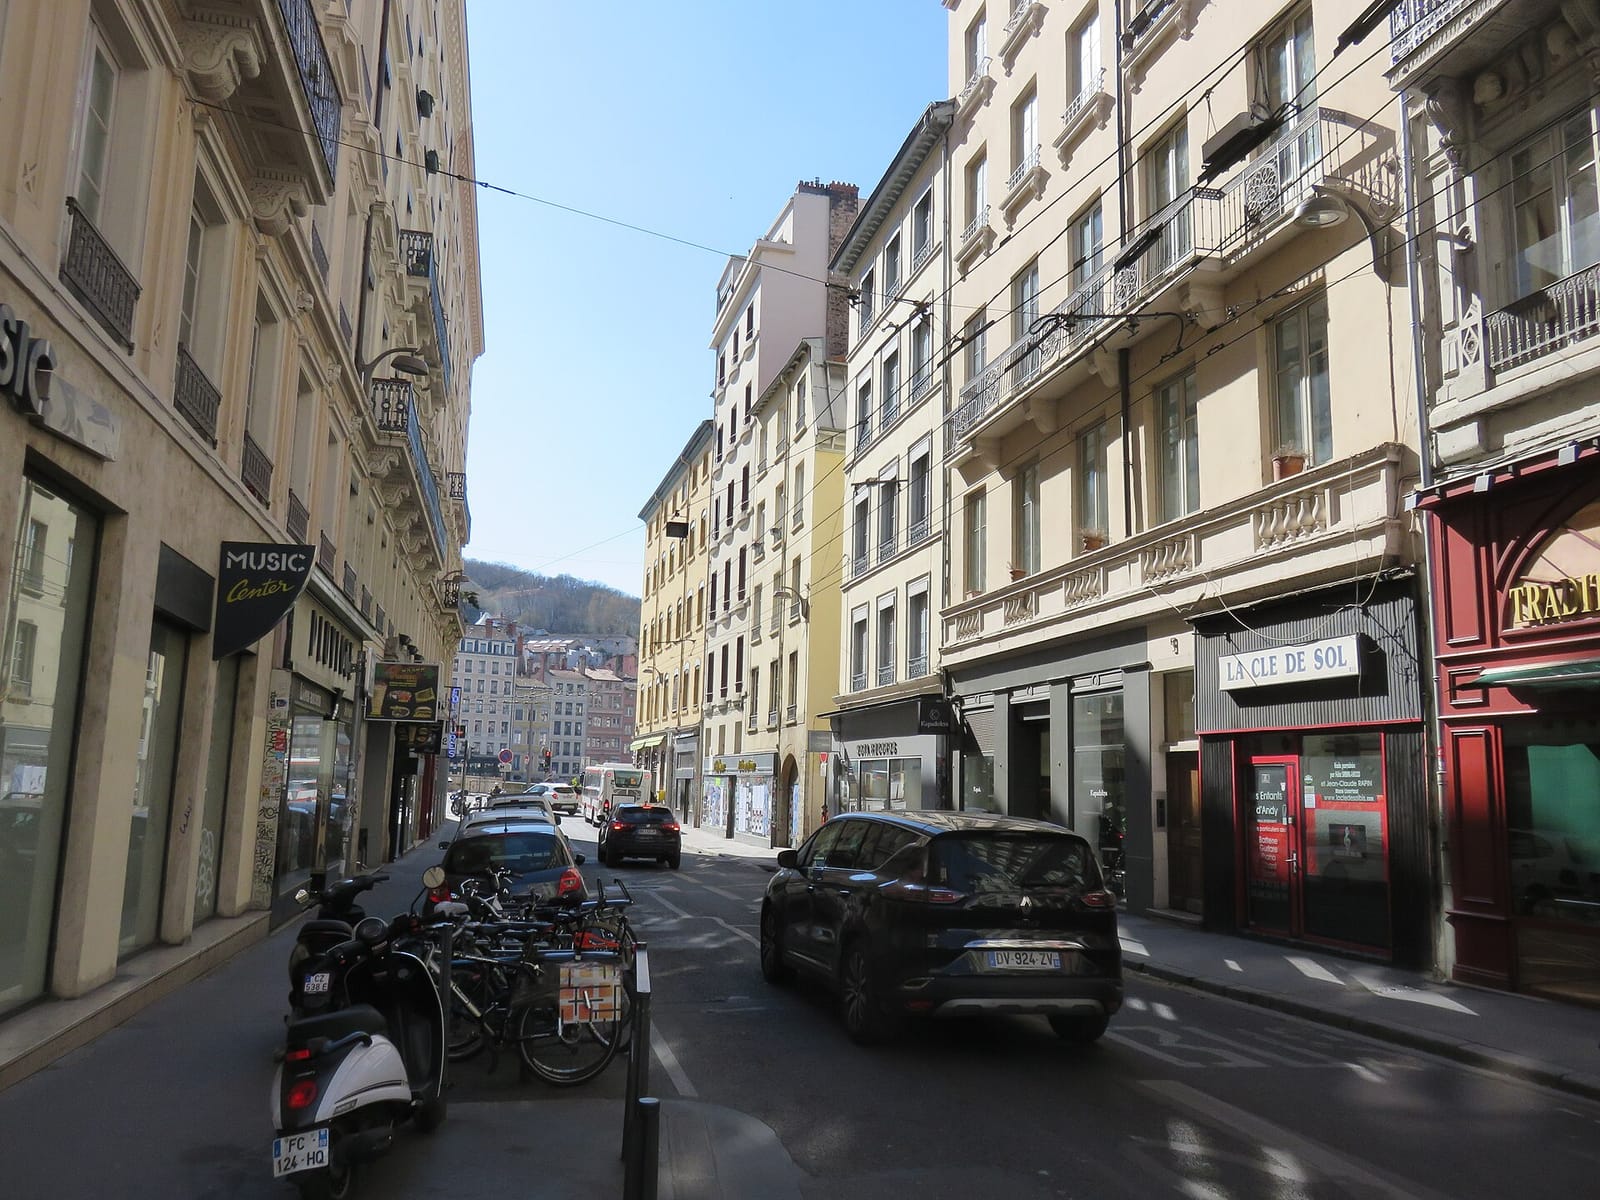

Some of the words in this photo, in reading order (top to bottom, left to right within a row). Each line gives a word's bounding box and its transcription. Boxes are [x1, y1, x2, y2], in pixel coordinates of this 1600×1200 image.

[226, 551, 306, 572] MUSIC
[226, 578, 295, 603] Center
[1227, 661, 1245, 681] LA
[1251, 655, 1278, 678] CLE
[1285, 651, 1306, 673] DE
[1314, 645, 1347, 670] SOL
[1260, 791, 1283, 800] Enfants
[1256, 805, 1279, 816] d'Andy
[995, 952, 1053, 966] DV-924-ZV
